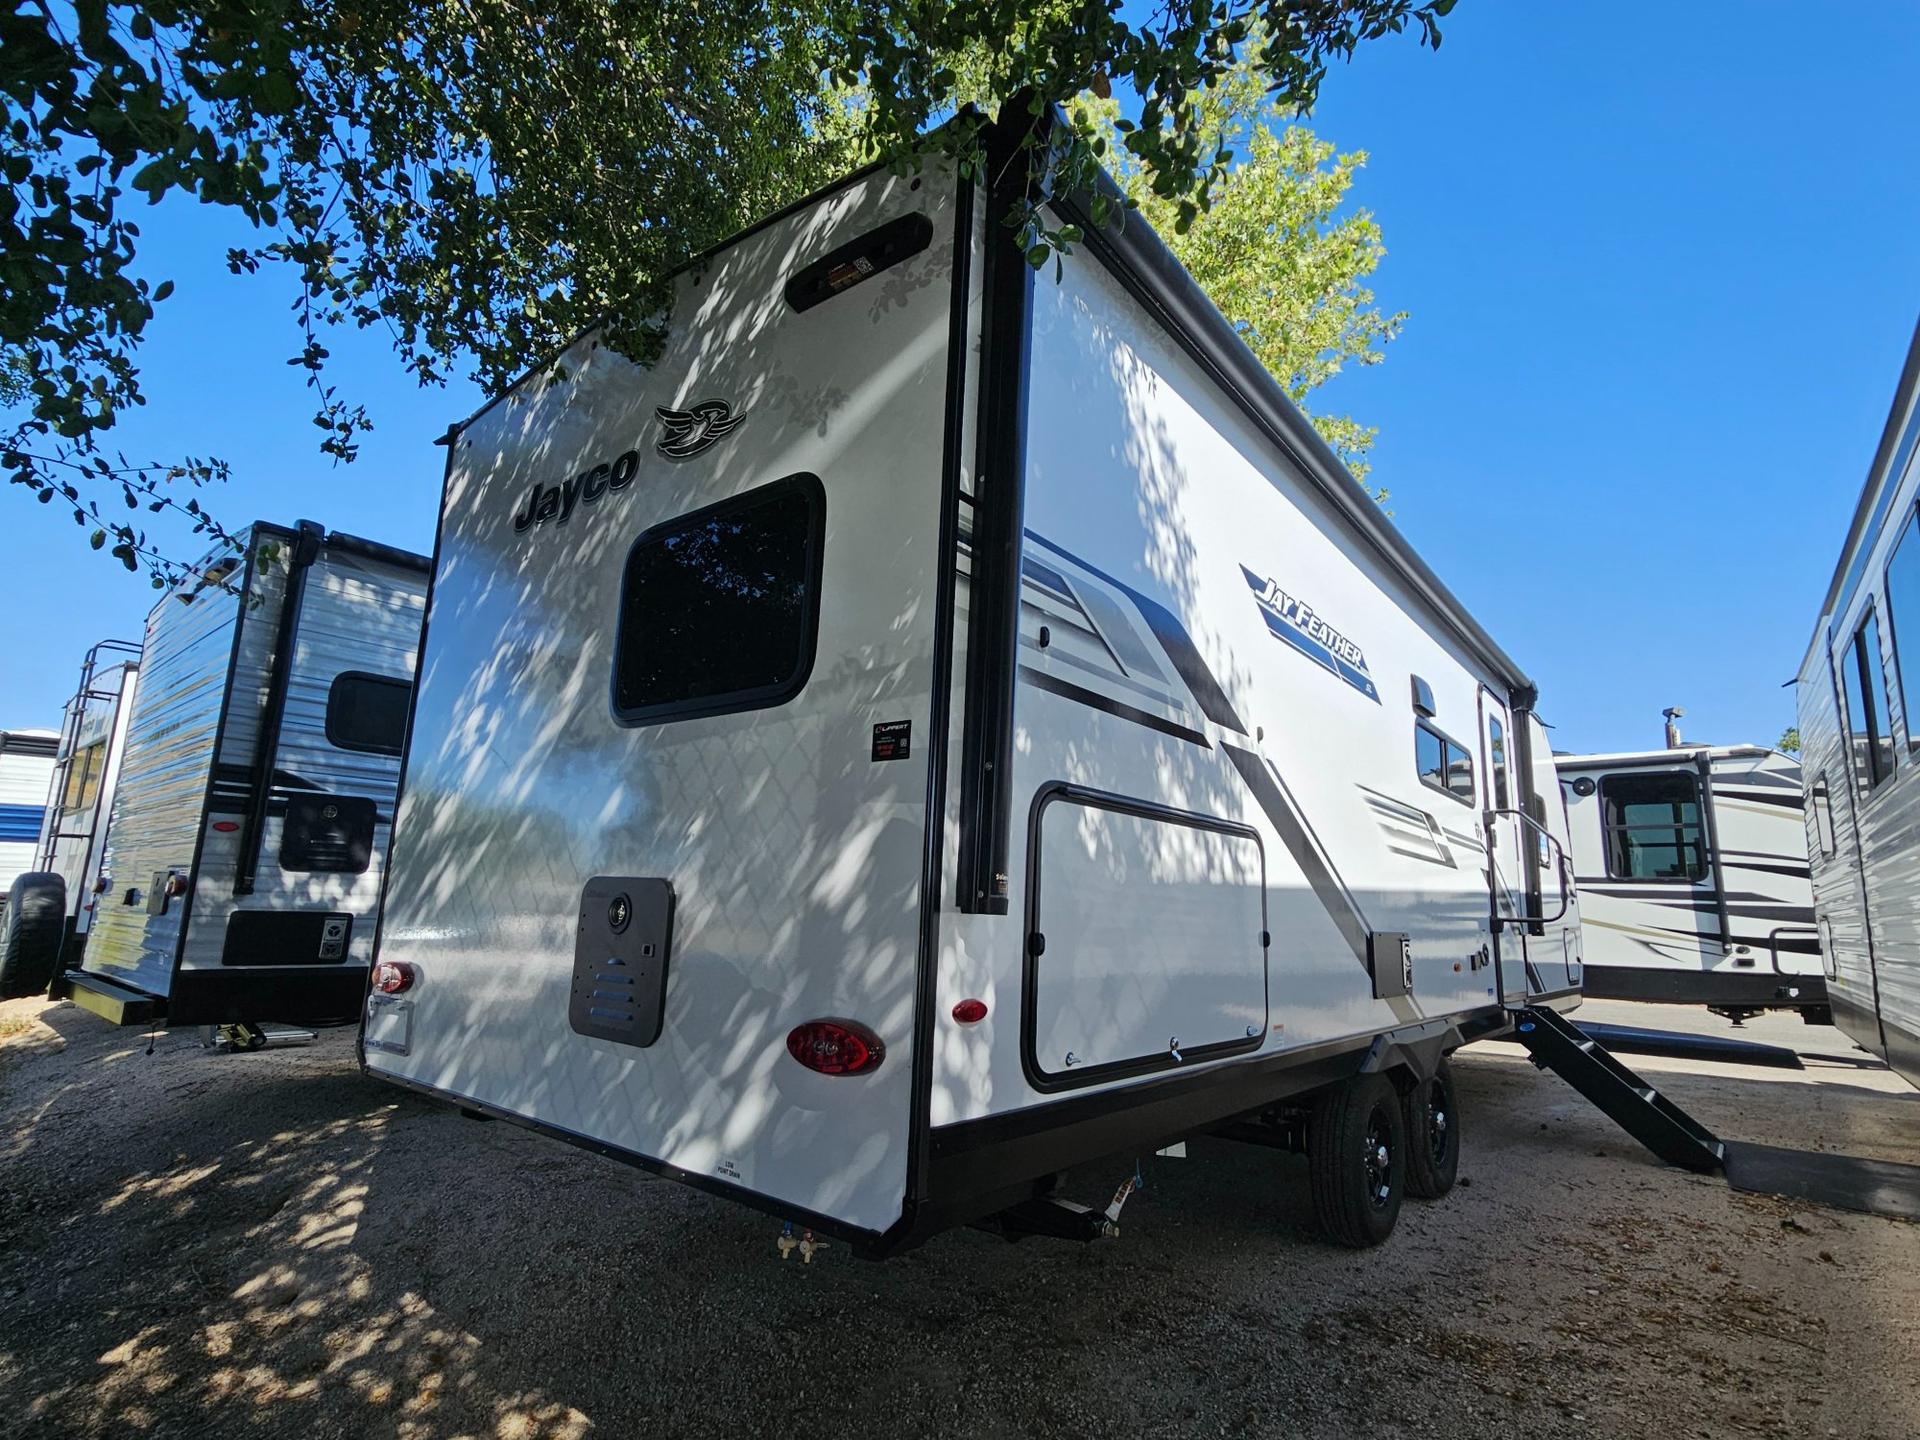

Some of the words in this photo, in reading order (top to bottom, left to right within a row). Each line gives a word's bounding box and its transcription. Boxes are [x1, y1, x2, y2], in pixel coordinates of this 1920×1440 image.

[514, 447, 640, 532] Jayco
[1254, 577, 1295, 618] JAY
[1295, 600, 1363, 667] FEATHER
